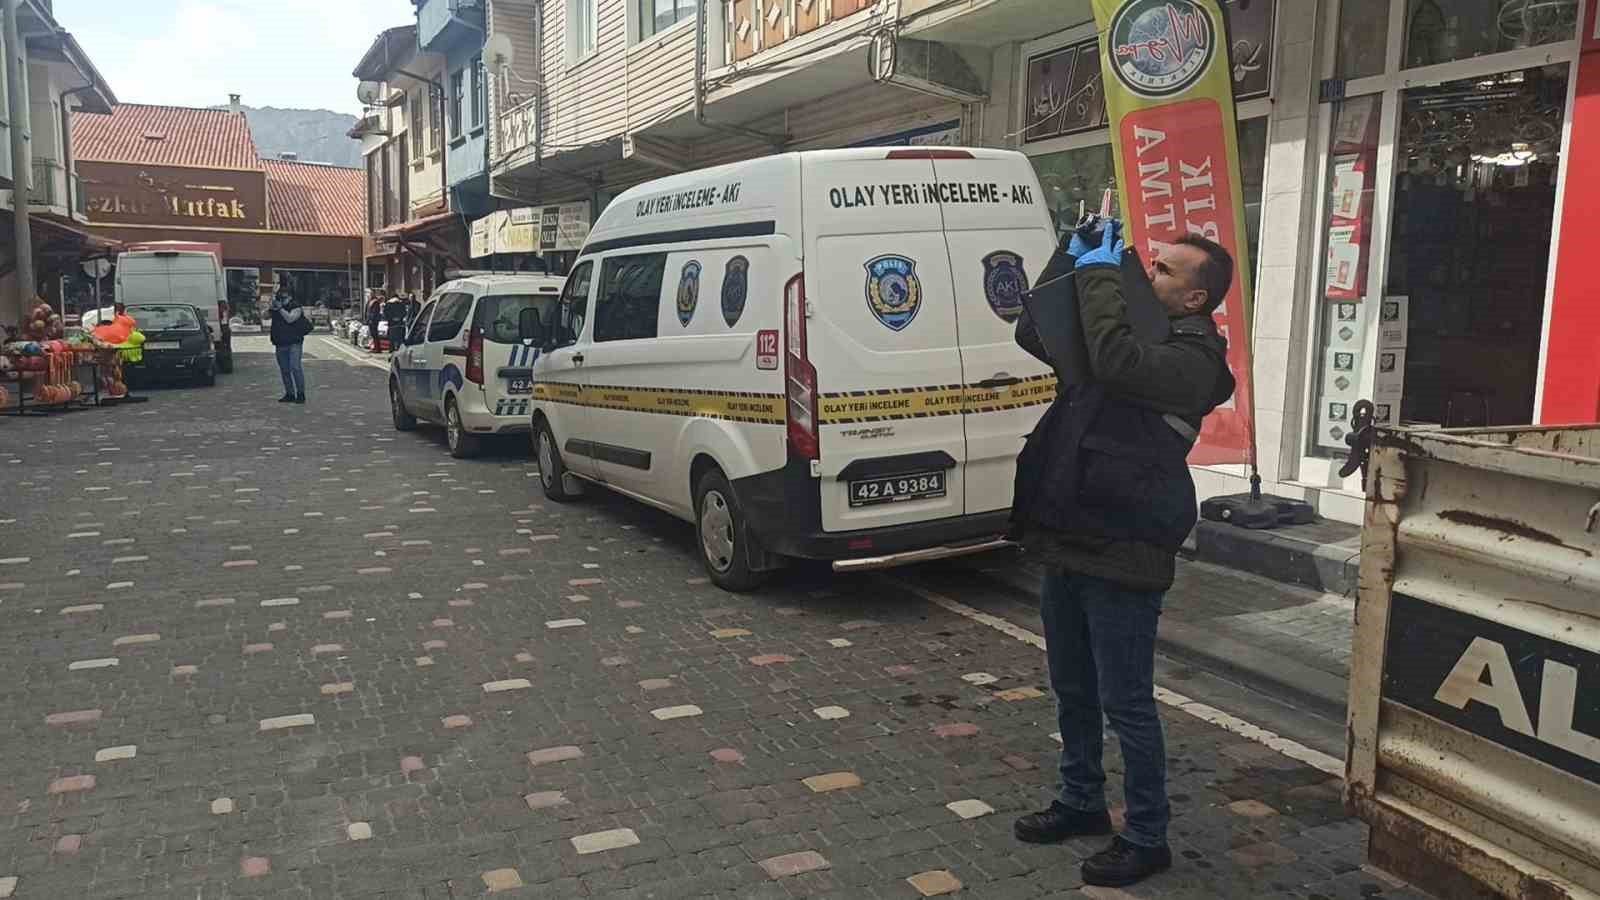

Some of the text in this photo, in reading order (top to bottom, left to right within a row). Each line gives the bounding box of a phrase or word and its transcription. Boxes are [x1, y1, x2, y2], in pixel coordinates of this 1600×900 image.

[829, 185, 875, 209] OLAY
[636, 199, 656, 217] OLAY
[759, 334, 776, 353] 112
[511, 380, 525, 390] 42
[823, 400, 847, 413] OLAY
[924, 394, 945, 407] OLAY
[857, 475, 939, 499] 42 A 9384
